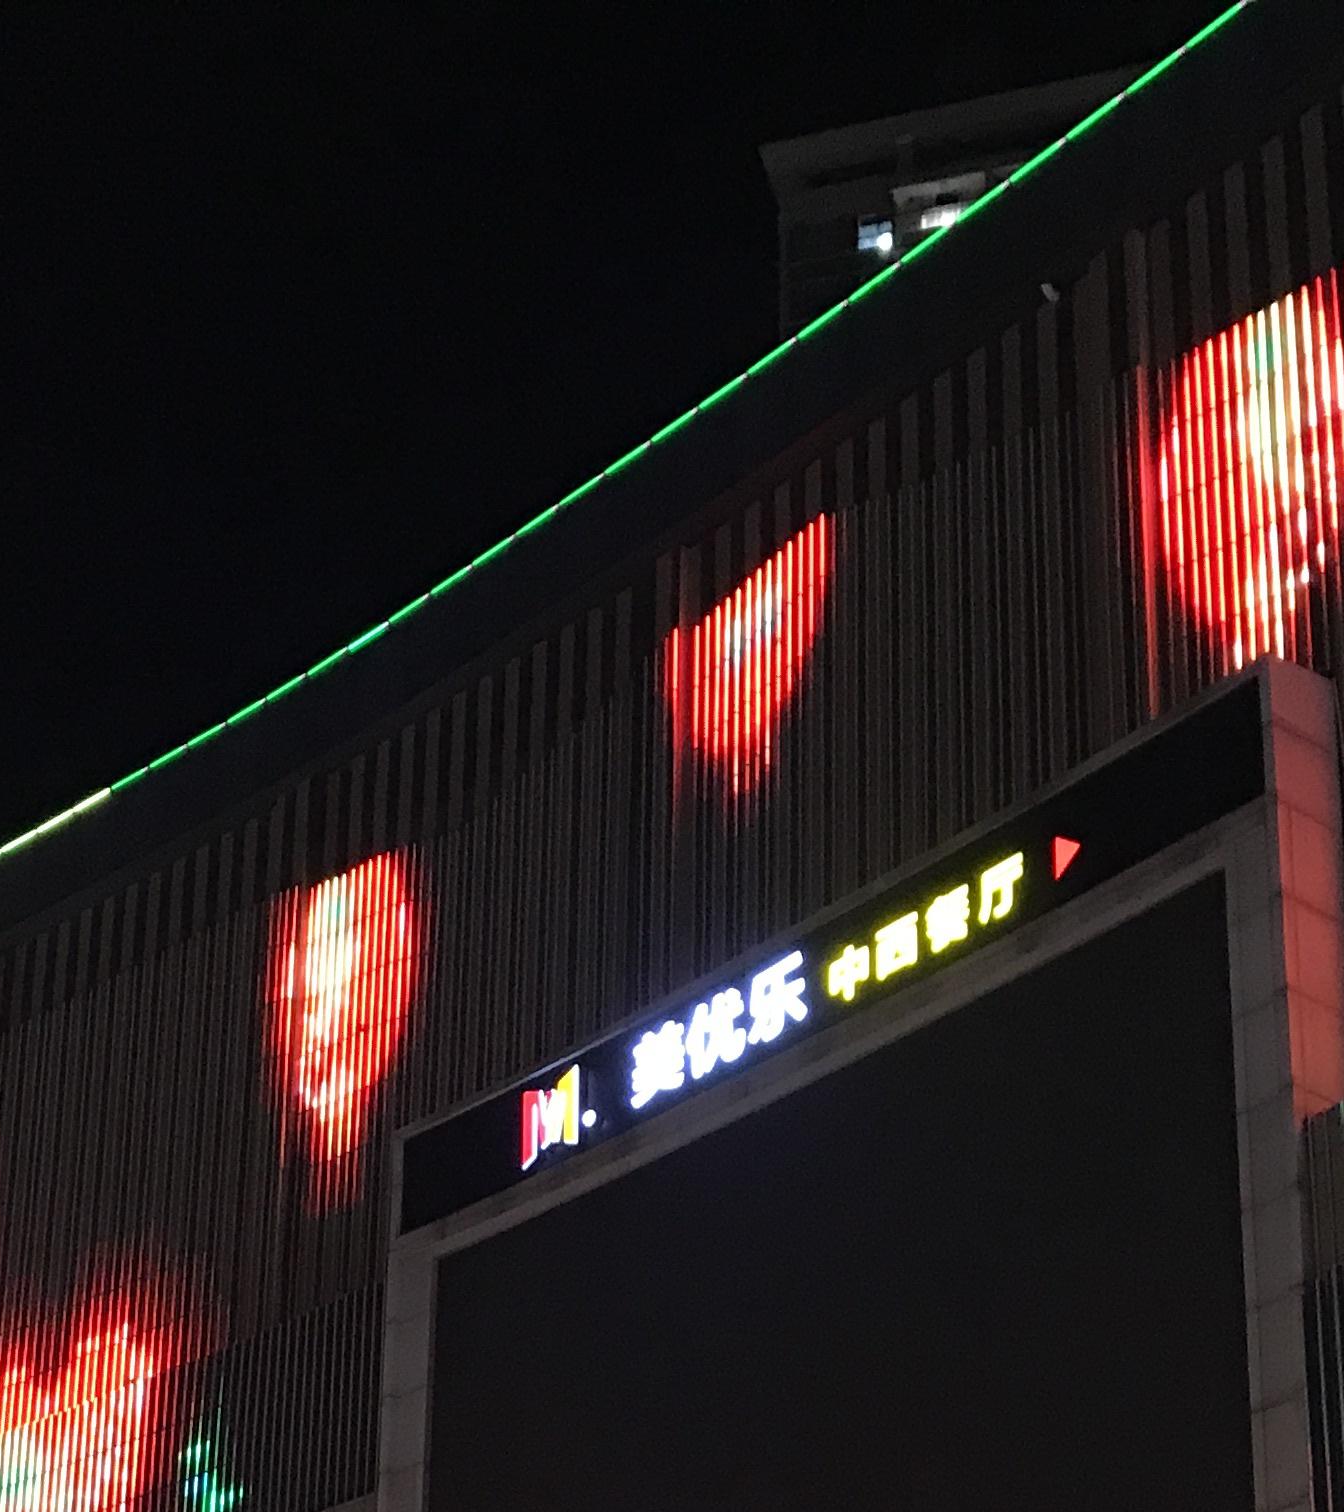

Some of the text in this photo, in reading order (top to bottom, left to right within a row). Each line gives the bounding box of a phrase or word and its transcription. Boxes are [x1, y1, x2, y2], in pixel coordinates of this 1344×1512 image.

[630, 950, 809, 1109] 美优乐
[827, 852, 1024, 1001] 中西餐厅
